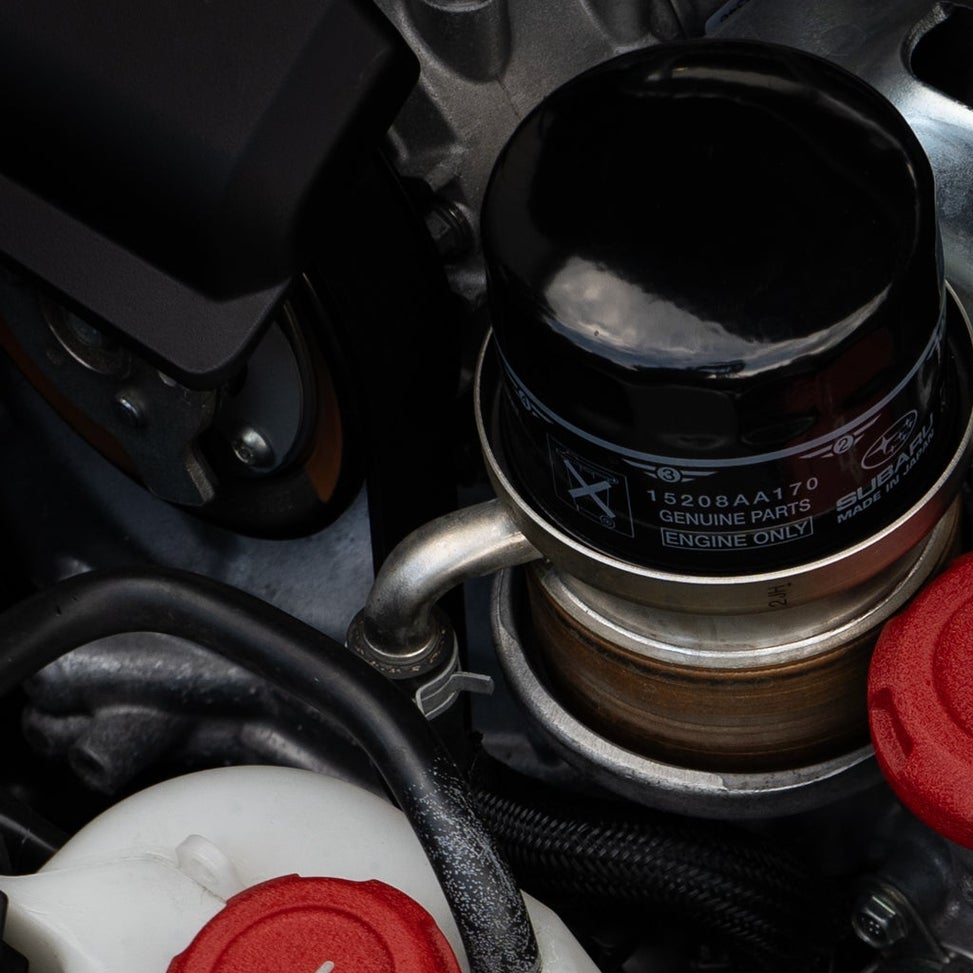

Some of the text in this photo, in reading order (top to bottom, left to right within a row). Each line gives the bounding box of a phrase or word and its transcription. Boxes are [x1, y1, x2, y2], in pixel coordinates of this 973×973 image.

[836, 412, 933, 512] SUBARU
[837, 427, 935, 524] MADE IN JAPAN
[647, 476, 819, 508] 15208AA170
[659, 499, 811, 526] GENUINE PARTS
[665, 520, 809, 548] ENGINE ONLY
